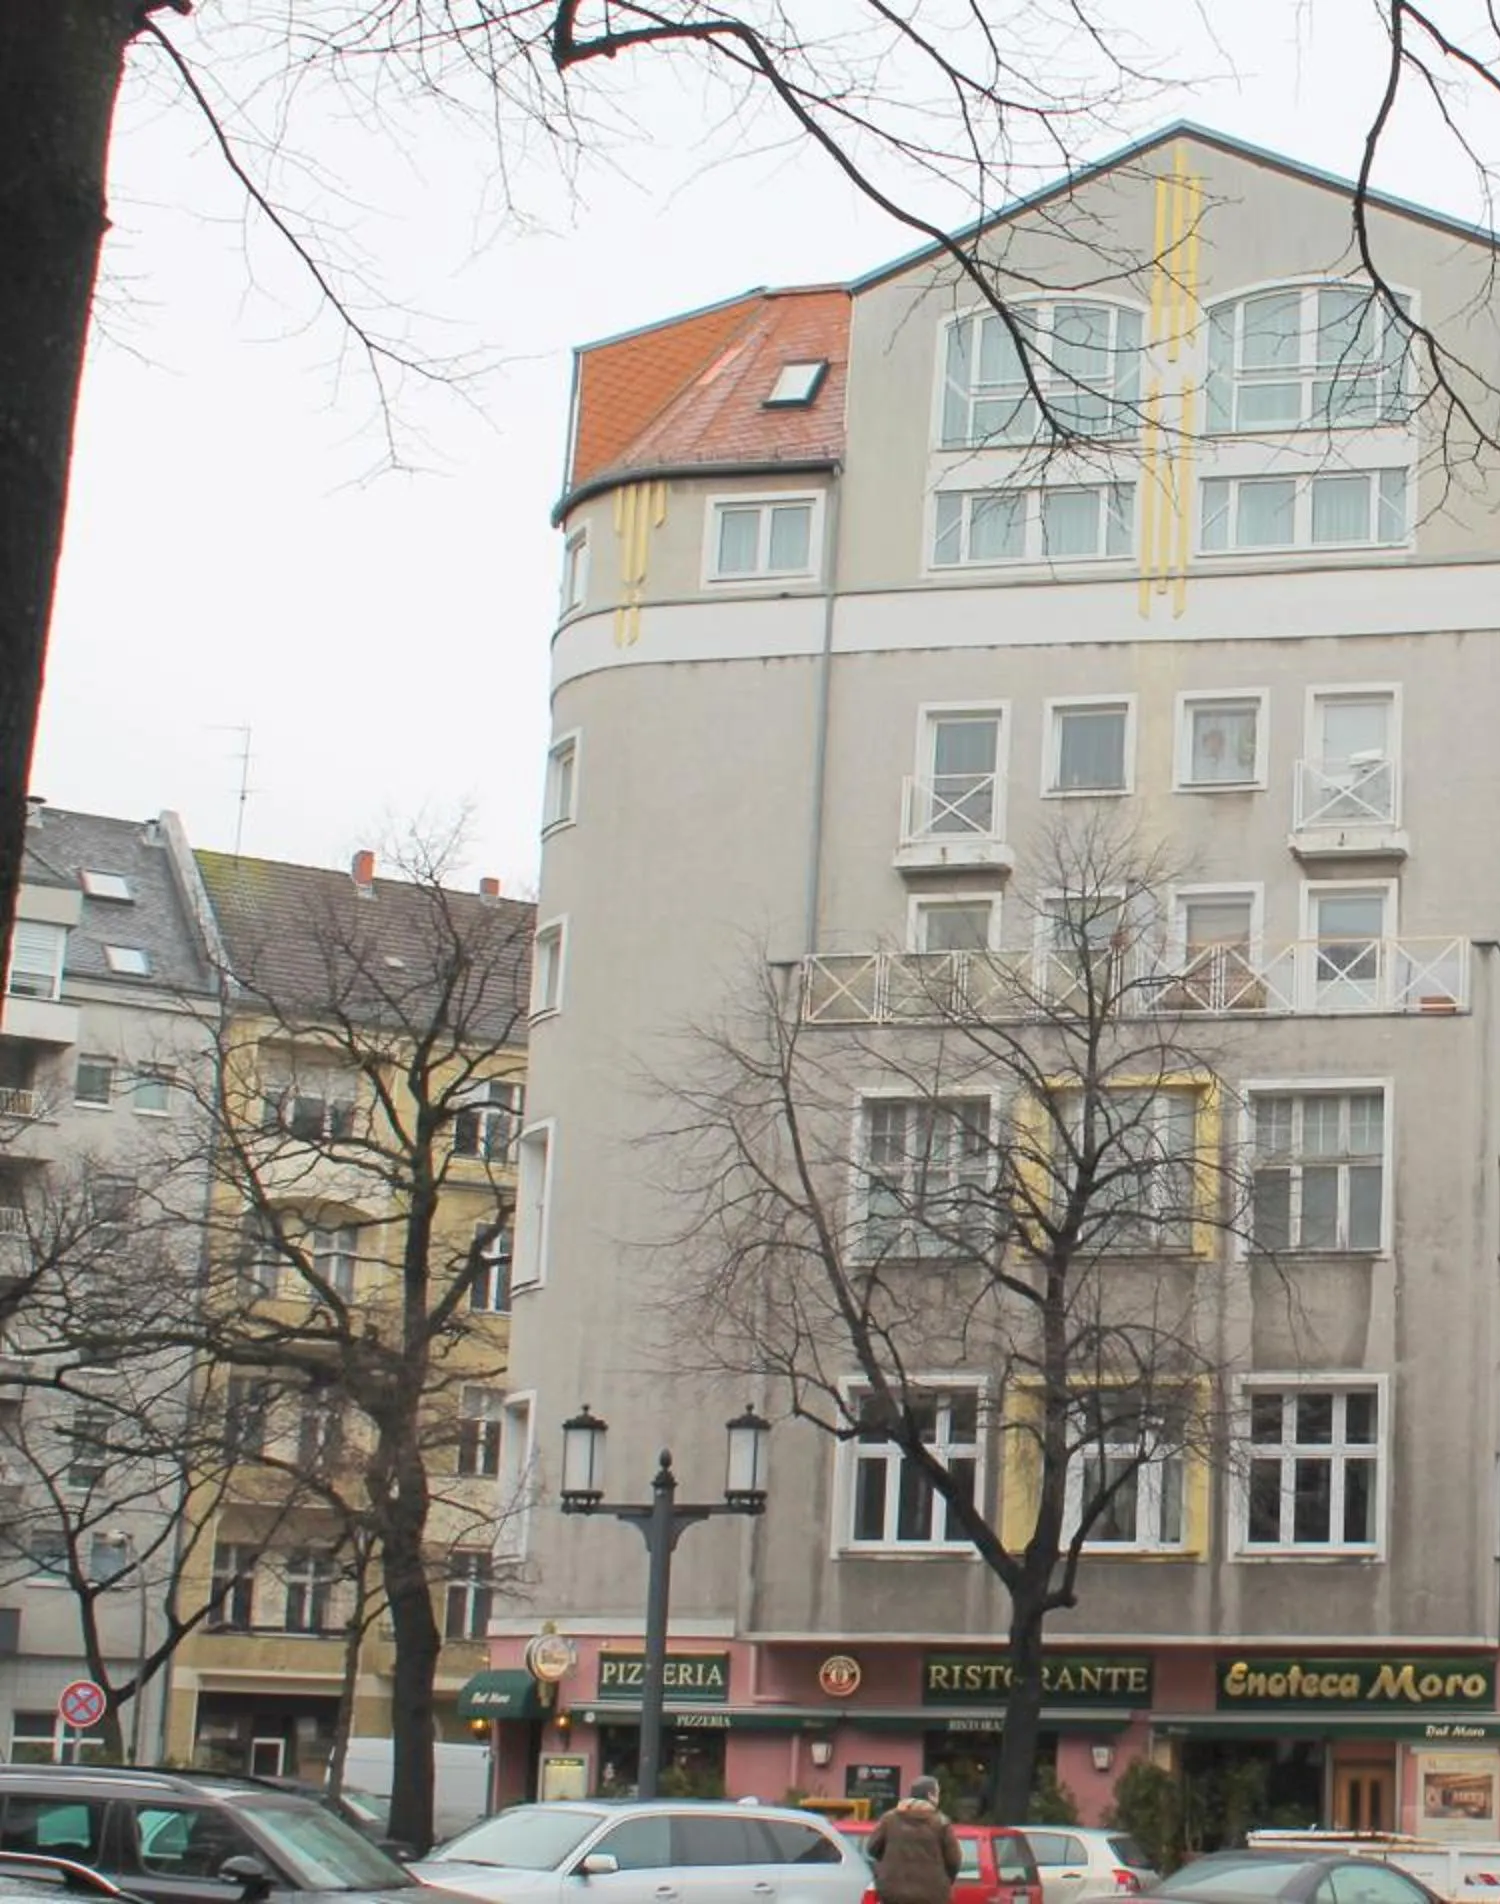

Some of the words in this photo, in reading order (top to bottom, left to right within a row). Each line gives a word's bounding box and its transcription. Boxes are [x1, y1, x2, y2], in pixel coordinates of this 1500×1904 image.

[602, 1662, 722, 1686] PIZERIA
[929, 1664, 1148, 1692] RISTRANTE
[1224, 1661, 1360, 1698] Enoteca
[1367, 1664, 1487, 1702] Moro
[1425, 1725, 1449, 1738] Dal
[1451, 1726, 1486, 1738] Moro
